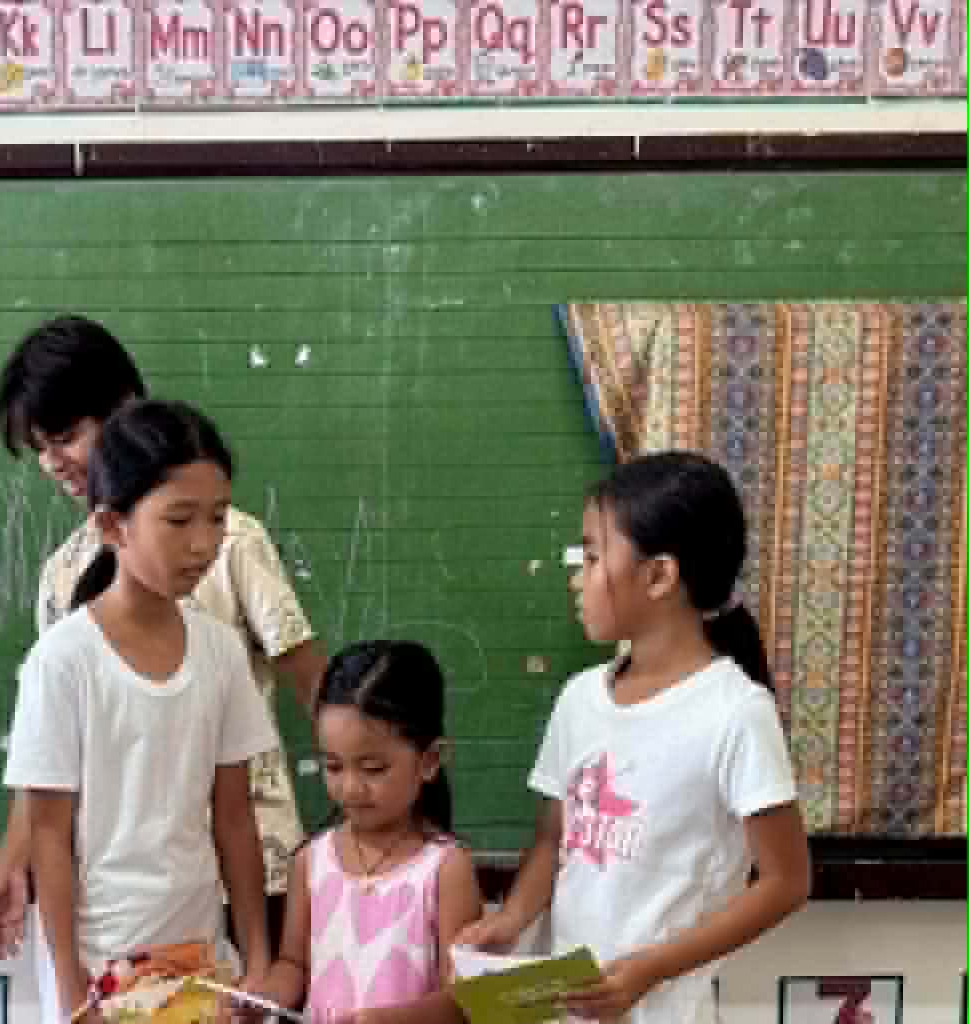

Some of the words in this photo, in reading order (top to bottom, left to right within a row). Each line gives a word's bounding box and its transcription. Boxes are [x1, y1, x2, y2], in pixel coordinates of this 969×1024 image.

[0, 12, 40, 57] Kk
[151, 13, 207, 60] Mm
[235, 9, 284, 57] Nn
[310, 9, 368, 55] Oo
[397, 6, 448, 64] Pp
[479, 5, 529, 64] Qq
[564, 2, 607, 48] Rr
[645, 1, 691, 46] Ss
[806, 0, 855, 47] Uu
[888, 0, 939, 46] Vv
